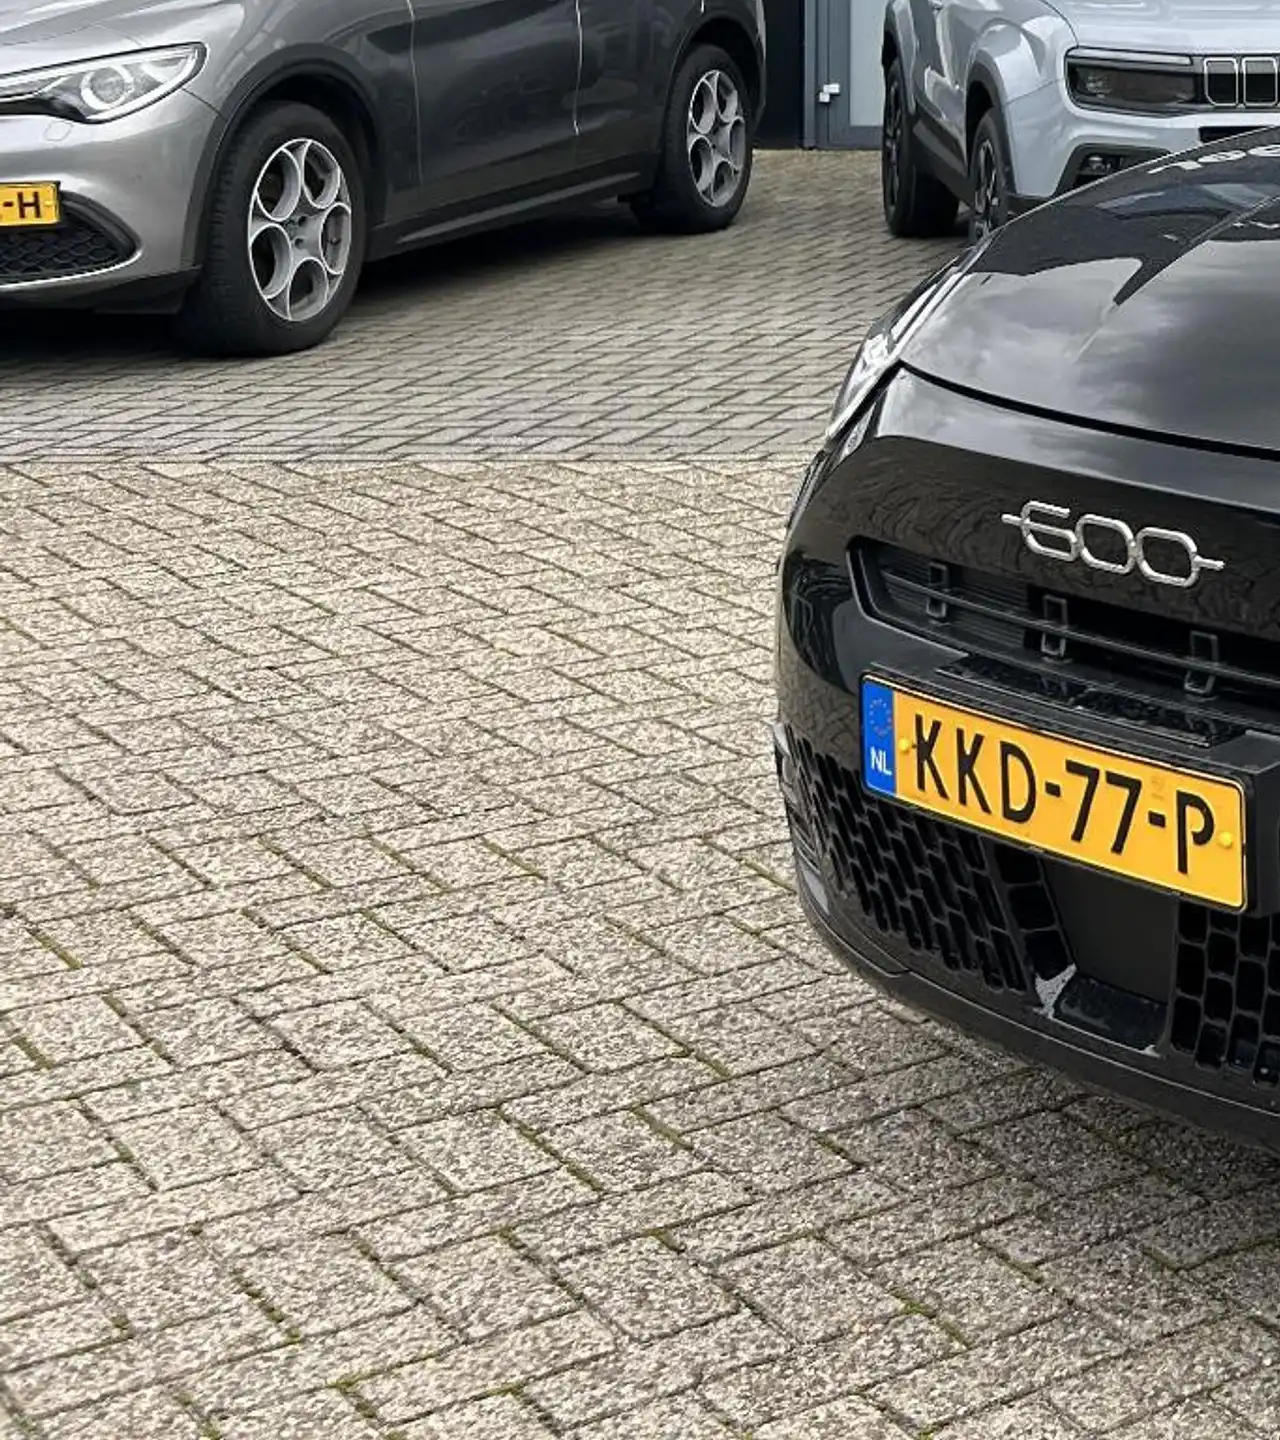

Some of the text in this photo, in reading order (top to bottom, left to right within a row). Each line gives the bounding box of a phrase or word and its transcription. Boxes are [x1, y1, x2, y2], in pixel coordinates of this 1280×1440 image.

[1018, 500, 1203, 587] 600
[870, 746, 893, 776] NL
[913, 713, 1216, 875] KKD-77-P
